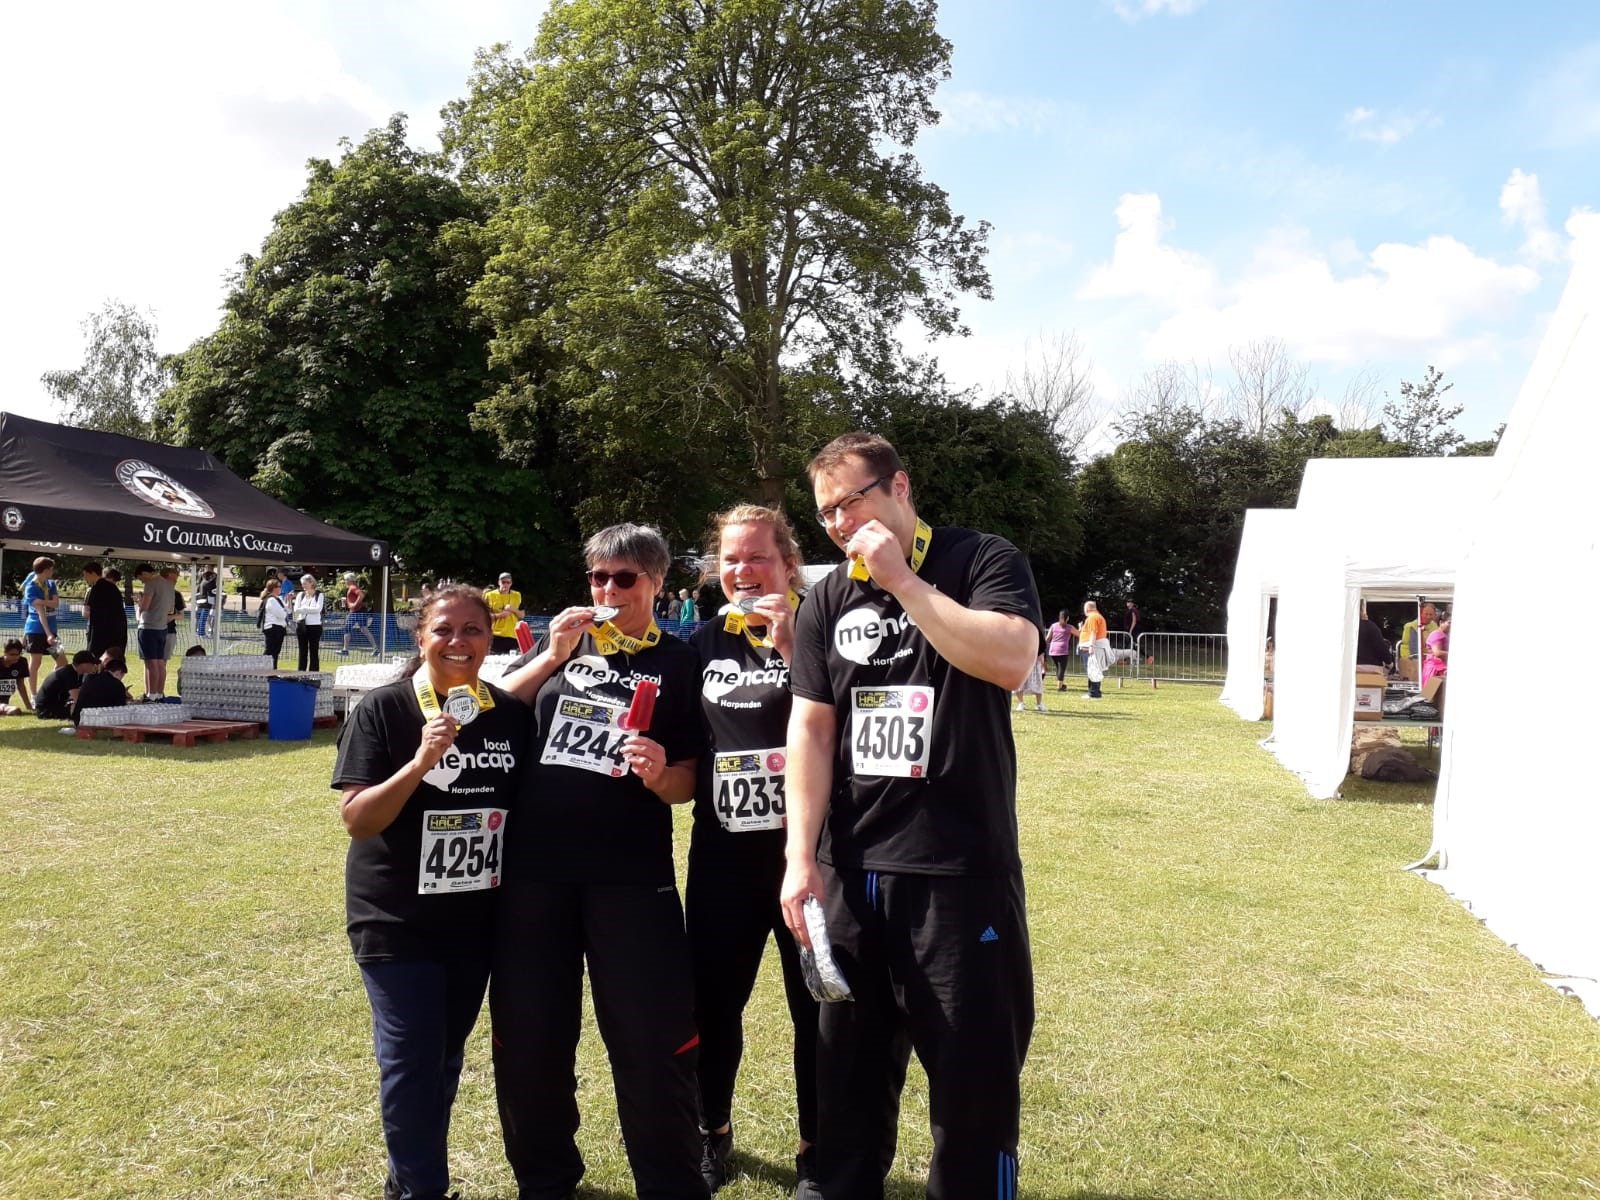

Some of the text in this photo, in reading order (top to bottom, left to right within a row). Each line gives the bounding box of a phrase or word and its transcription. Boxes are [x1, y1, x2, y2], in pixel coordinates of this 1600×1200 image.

[838, 612, 917, 647] menc
[764, 657, 789, 669] loc
[872, 647, 914, 667] Harpden
[568, 662, 661, 699] menc
[720, 699, 762, 710] Harpenden
[483, 738, 511, 751] local
[550, 721, 630, 766] 4244
[856, 715, 925, 762] 4303
[451, 786, 495, 795] Harpenden
[718, 775, 787, 819] 4233
[430, 819, 463, 828] HALF
[425, 833, 499, 879] 4254
